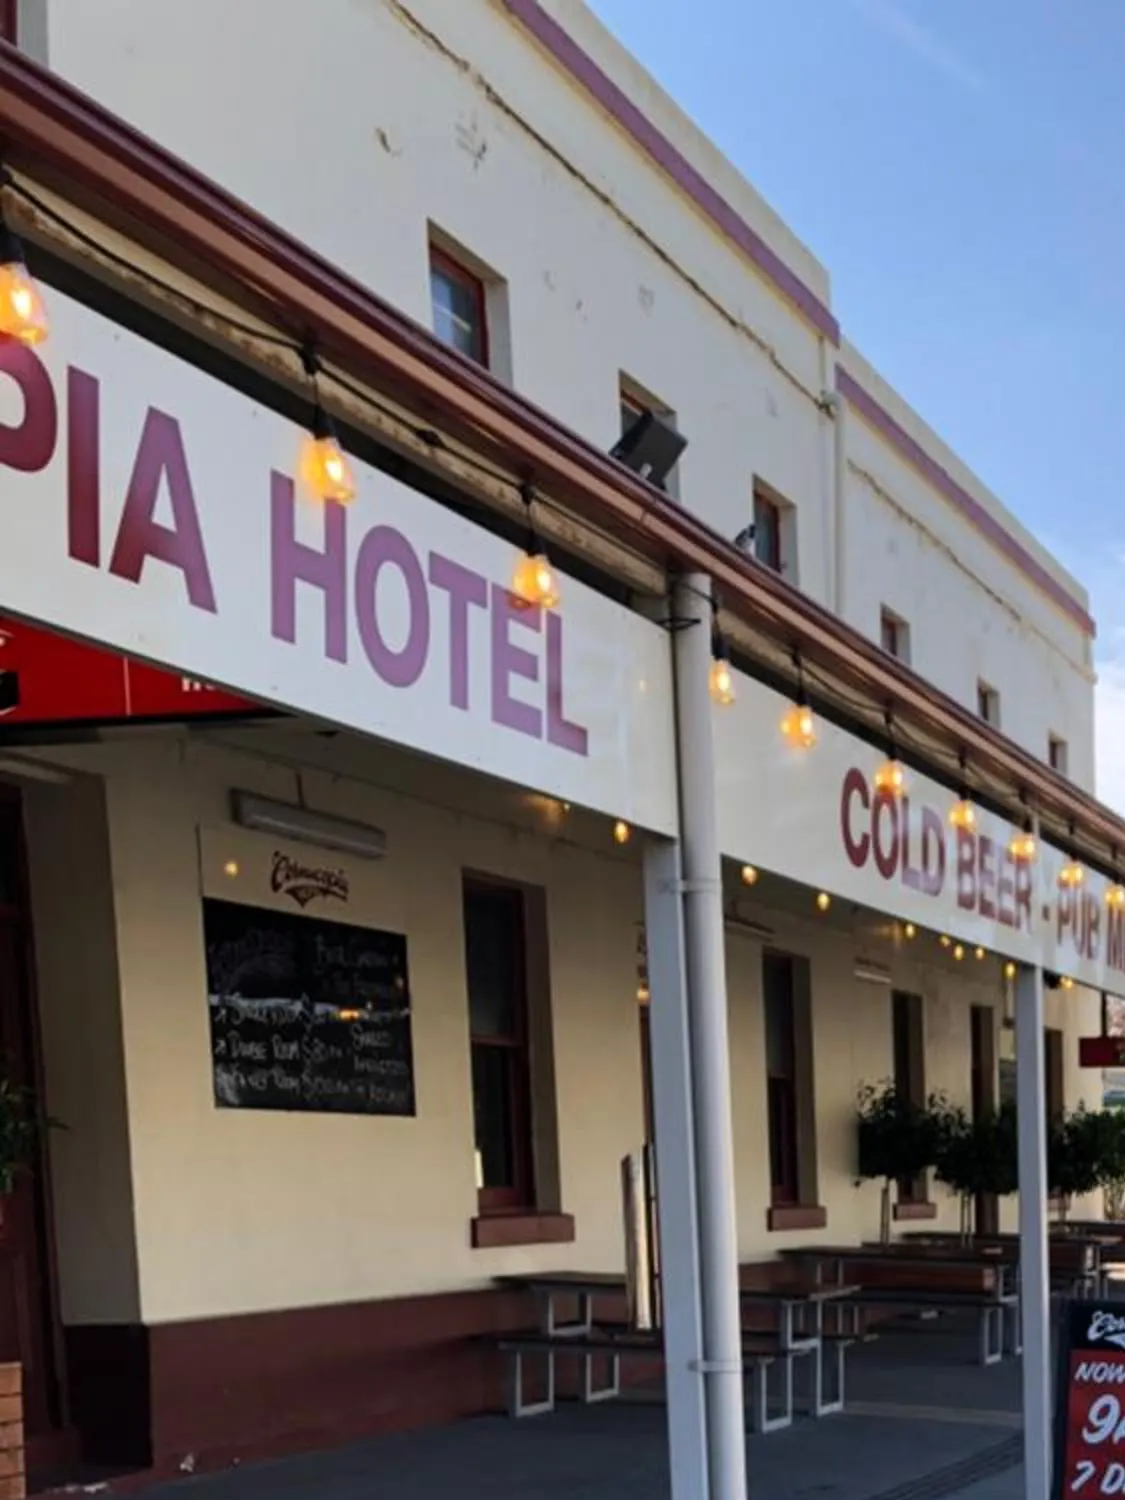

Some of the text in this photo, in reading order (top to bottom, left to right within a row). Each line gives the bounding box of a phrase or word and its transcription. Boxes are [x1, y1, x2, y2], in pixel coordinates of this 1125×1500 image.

[271, 469, 588, 756] HOTEL
[841, 767, 946, 897] COLD
[957, 823, 1032, 935] BEER
[1056, 876, 1100, 960] PUB
[1071, 1460, 1096, 1492] 7
